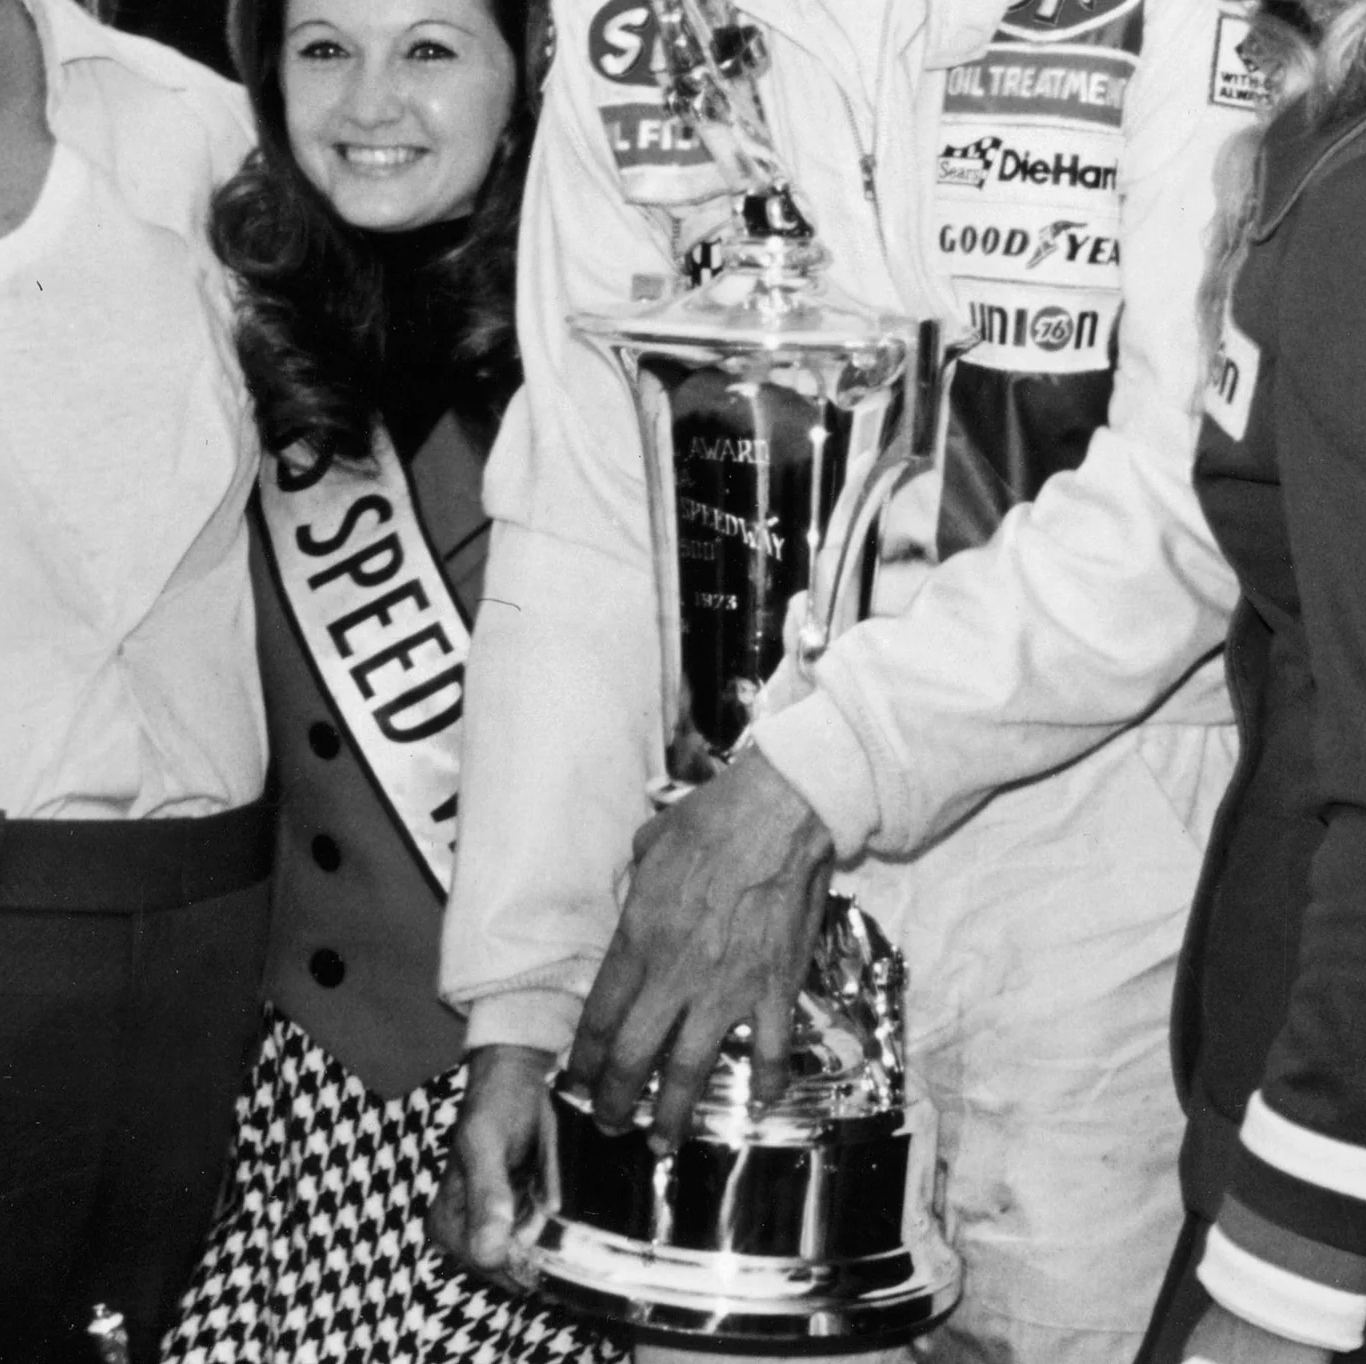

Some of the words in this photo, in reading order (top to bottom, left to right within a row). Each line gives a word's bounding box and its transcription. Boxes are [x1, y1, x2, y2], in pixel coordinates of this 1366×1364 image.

[947, 65, 984, 97] OIL
[938, 159, 983, 182] Sears
[939, 223, 1031, 258] GOOD
[1065, 233, 1121, 268] YEA
[1035, 315, 1069, 342] 76
[685, 436, 771, 465] AWARD
[681, 496, 785, 561] SPEEDWAY
[296, 494, 464, 743] SPEED
